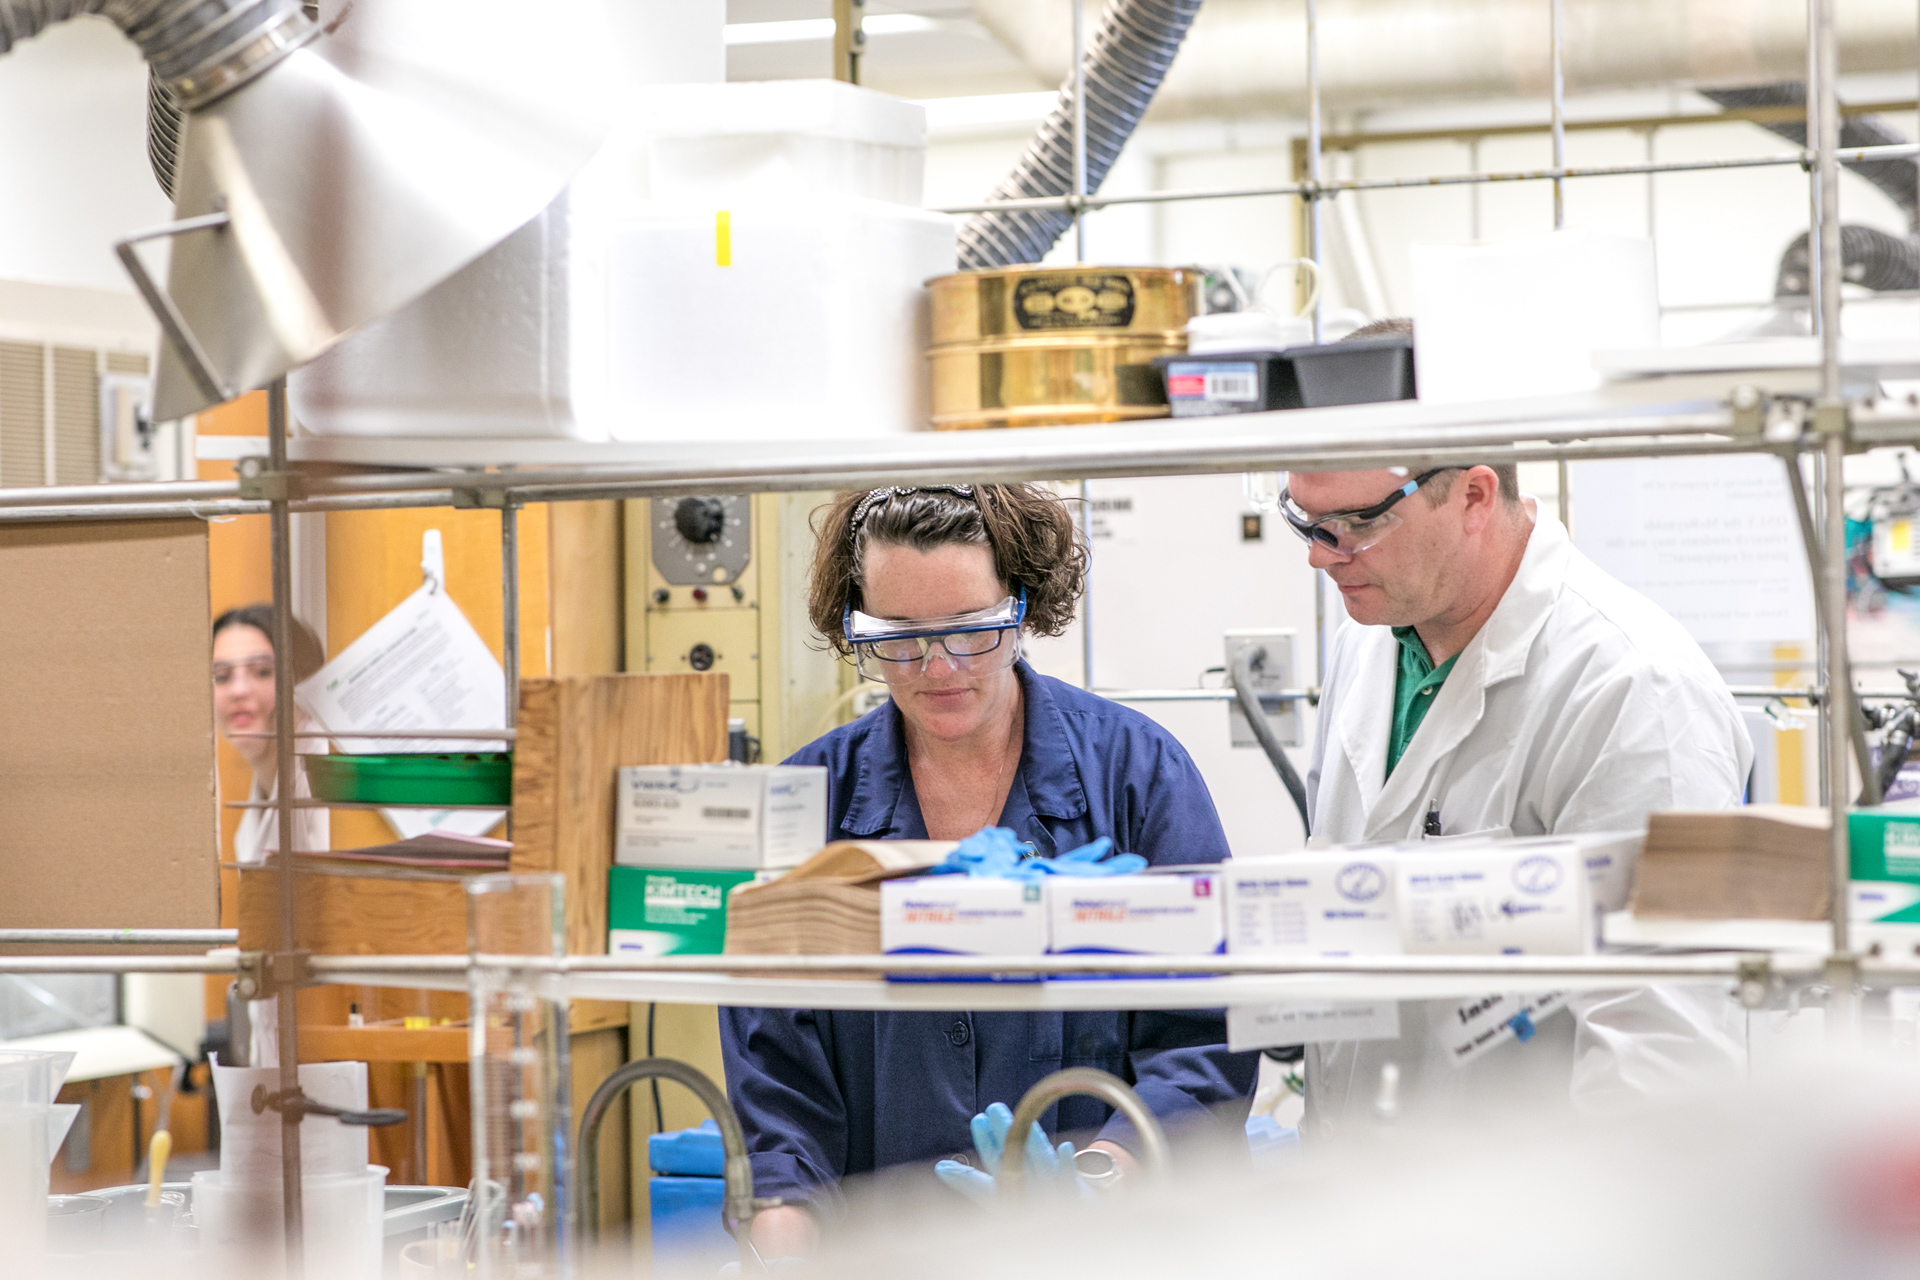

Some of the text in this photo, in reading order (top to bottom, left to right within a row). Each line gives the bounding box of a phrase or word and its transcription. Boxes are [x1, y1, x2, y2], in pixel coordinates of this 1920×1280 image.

[645, 882, 722, 899] KIMTECH
[904, 910, 955, 924] NITRILE
[1073, 908, 1126, 922] NITRILE
